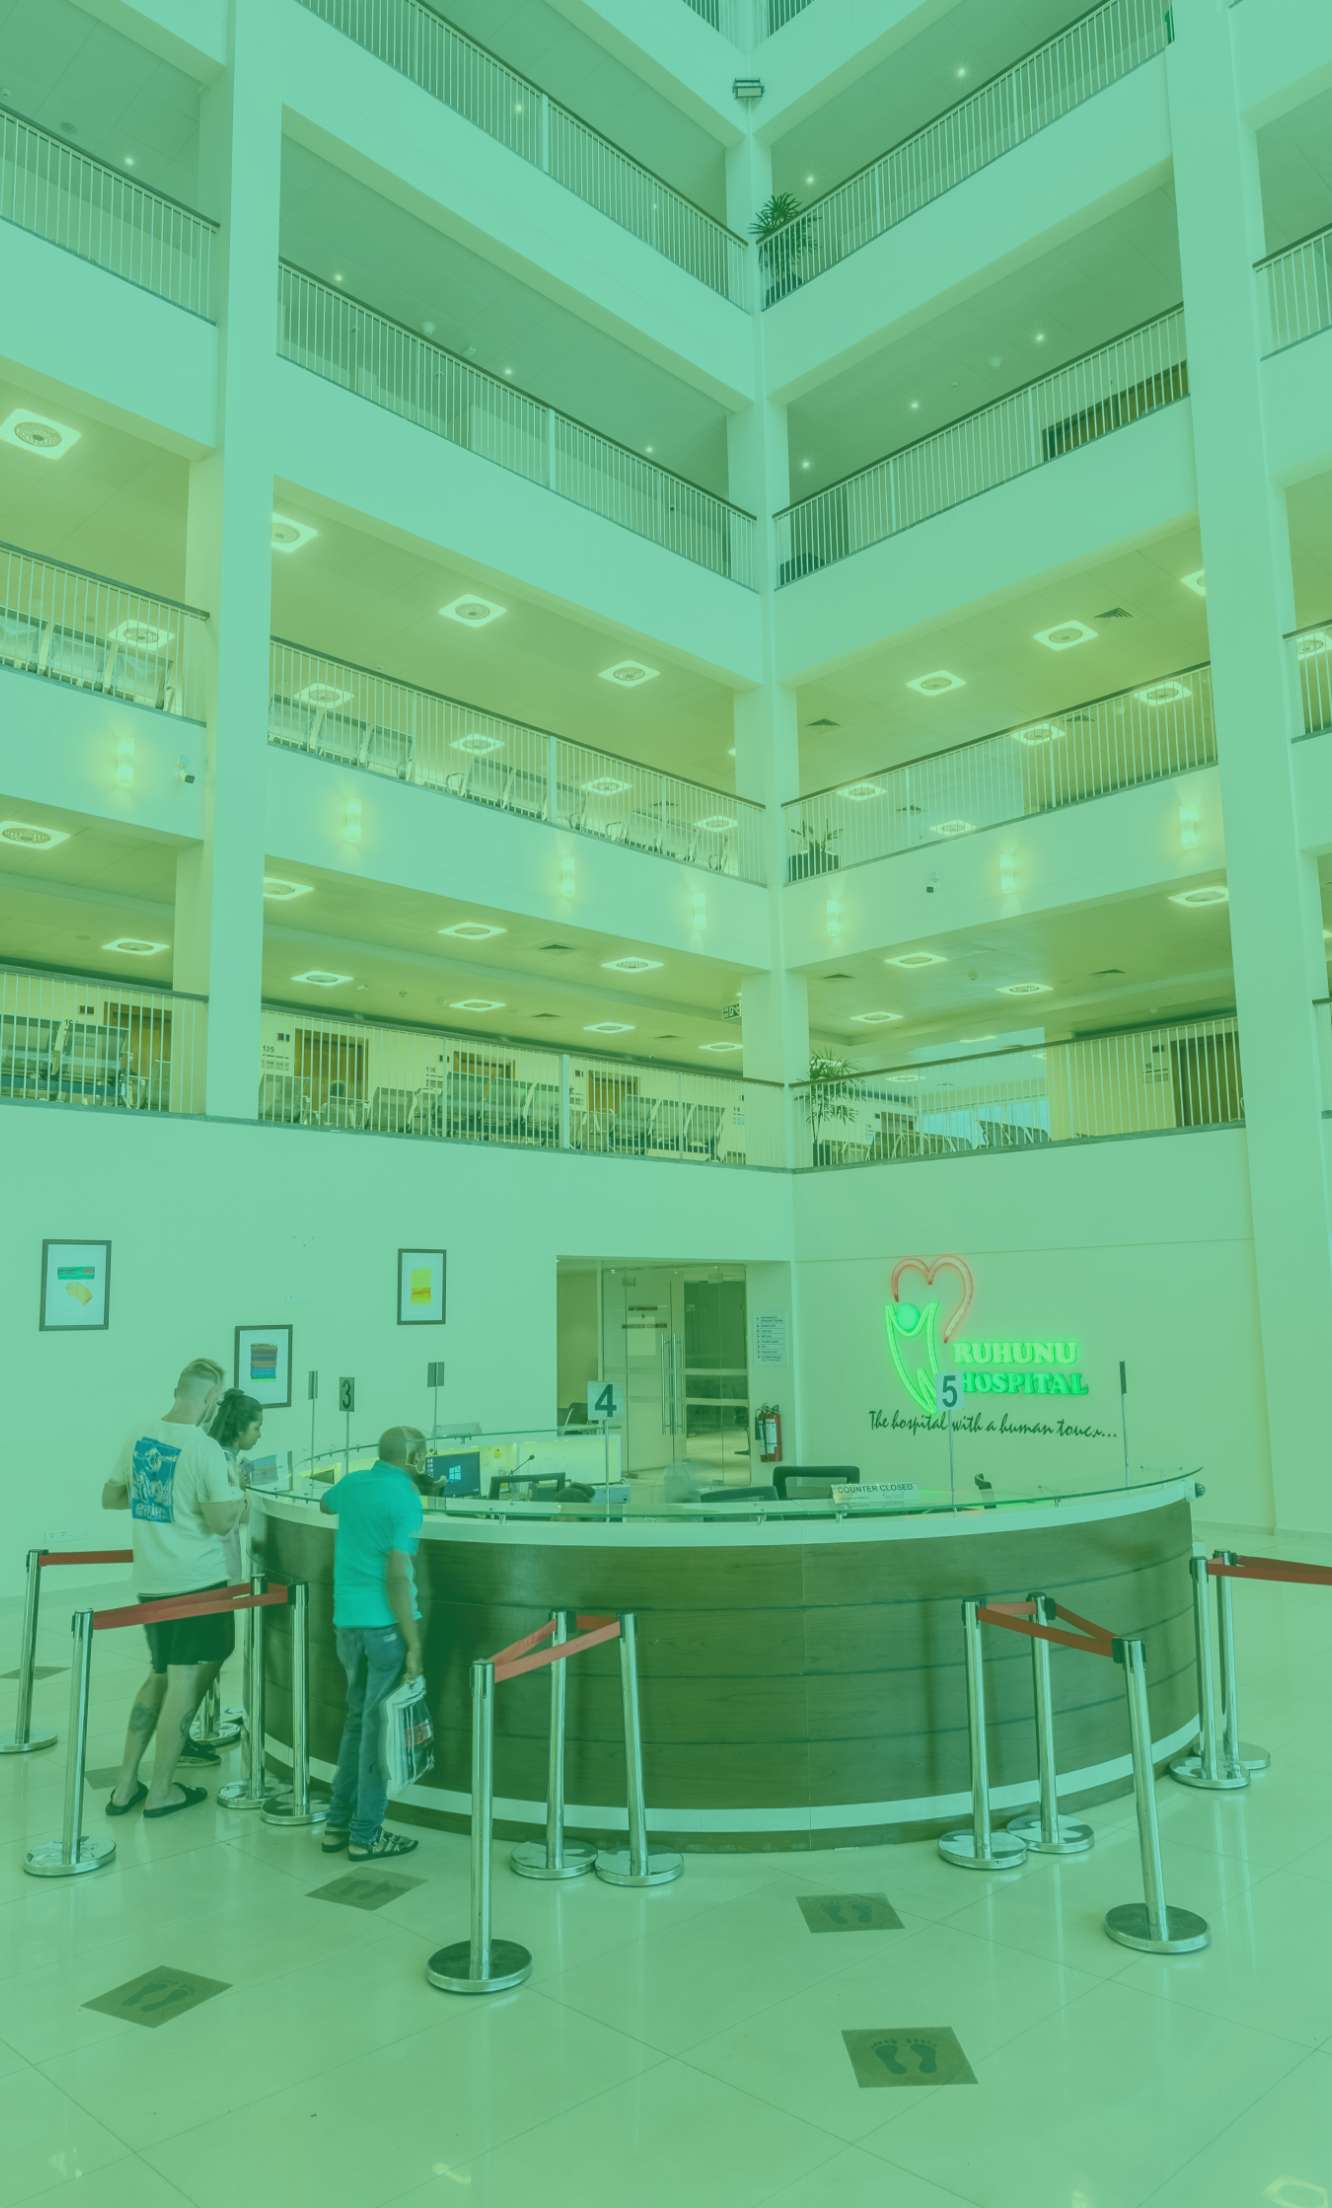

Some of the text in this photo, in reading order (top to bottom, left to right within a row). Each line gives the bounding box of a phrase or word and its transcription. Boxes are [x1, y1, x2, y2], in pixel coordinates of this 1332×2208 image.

[953, 1342, 1078, 1363] RUHUNU
[342, 1379, 352, 1410] 3
[942, 1374, 958, 1408] 5
[962, 1371, 1088, 1395] HOSPITAL
[594, 1383, 617, 1417] 4
[868, 1409, 889, 1431] The
[891, 1409, 948, 1436] hospital
[952, 1412, 983, 1432] with
[985, 1420, 997, 1431] a
[1000, 1413, 1053, 1435] human
[838, 1484, 878, 1494] COUNTER
